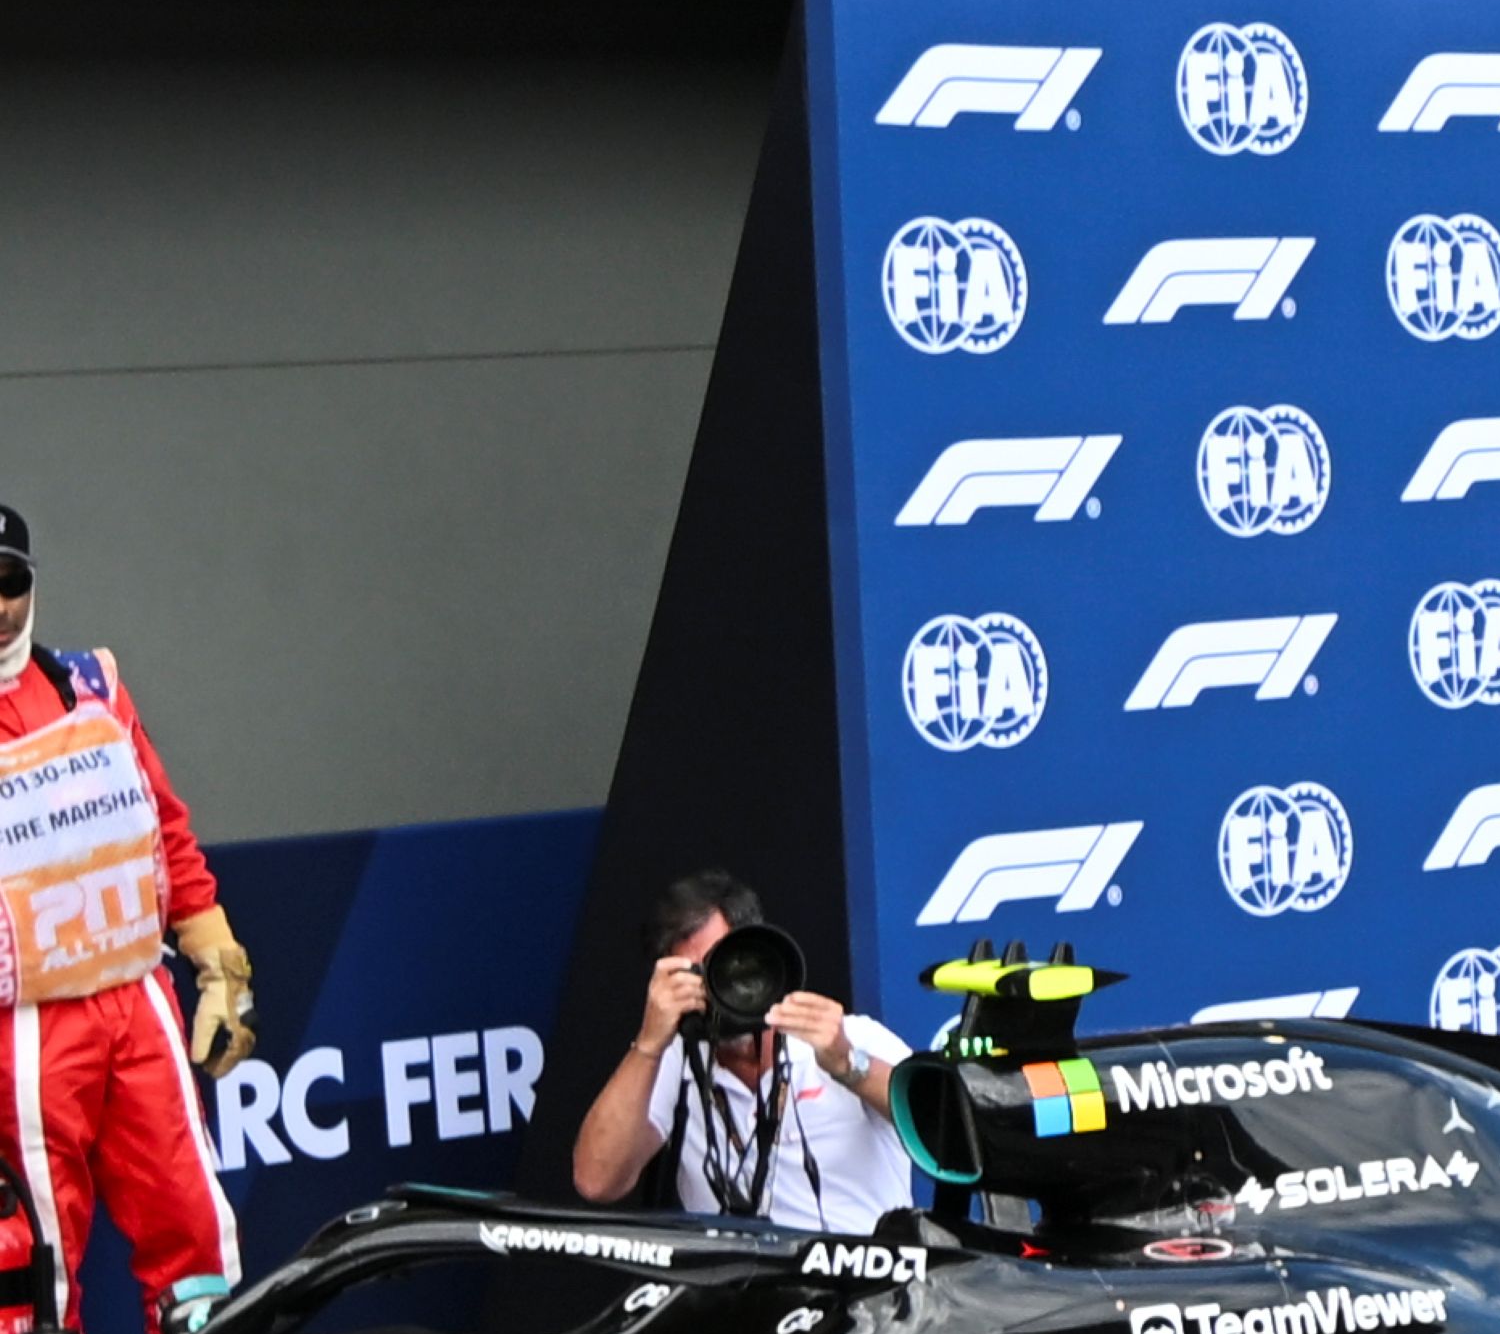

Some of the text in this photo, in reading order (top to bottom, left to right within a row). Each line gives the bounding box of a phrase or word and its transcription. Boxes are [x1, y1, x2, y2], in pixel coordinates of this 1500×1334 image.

[876, 45, 1102, 130] F1
[1104, 238, 1315, 323] F1
[896, 435, 1122, 525] F1
[1125, 614, 1337, 710] F1
[49, 786, 147, 831] MARSHA
[917, 822, 1143, 925] F1
[1111, 1046, 1334, 1114] Microsoft
[1274, 1157, 1448, 1211] SOLERA
[490, 1224, 675, 1268] CROWDSTRIKE
[802, 1242, 894, 1279] AMD
